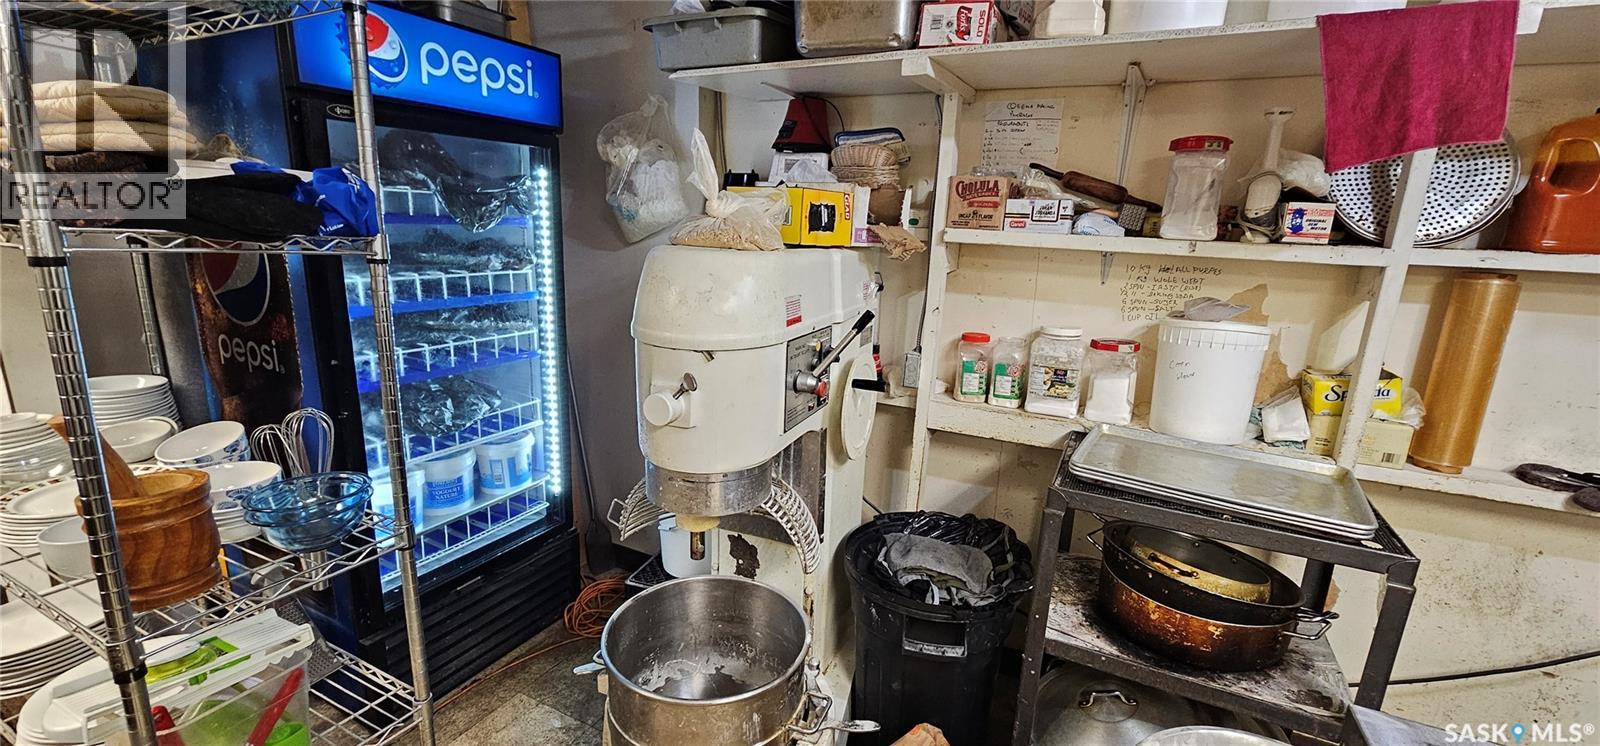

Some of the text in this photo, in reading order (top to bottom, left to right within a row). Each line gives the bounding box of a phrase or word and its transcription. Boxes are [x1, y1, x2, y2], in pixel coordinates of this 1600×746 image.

[959, 8, 969, 33] Forks
[976, 9, 986, 38] SOLO
[956, 180, 1000, 198] CHOLULA
